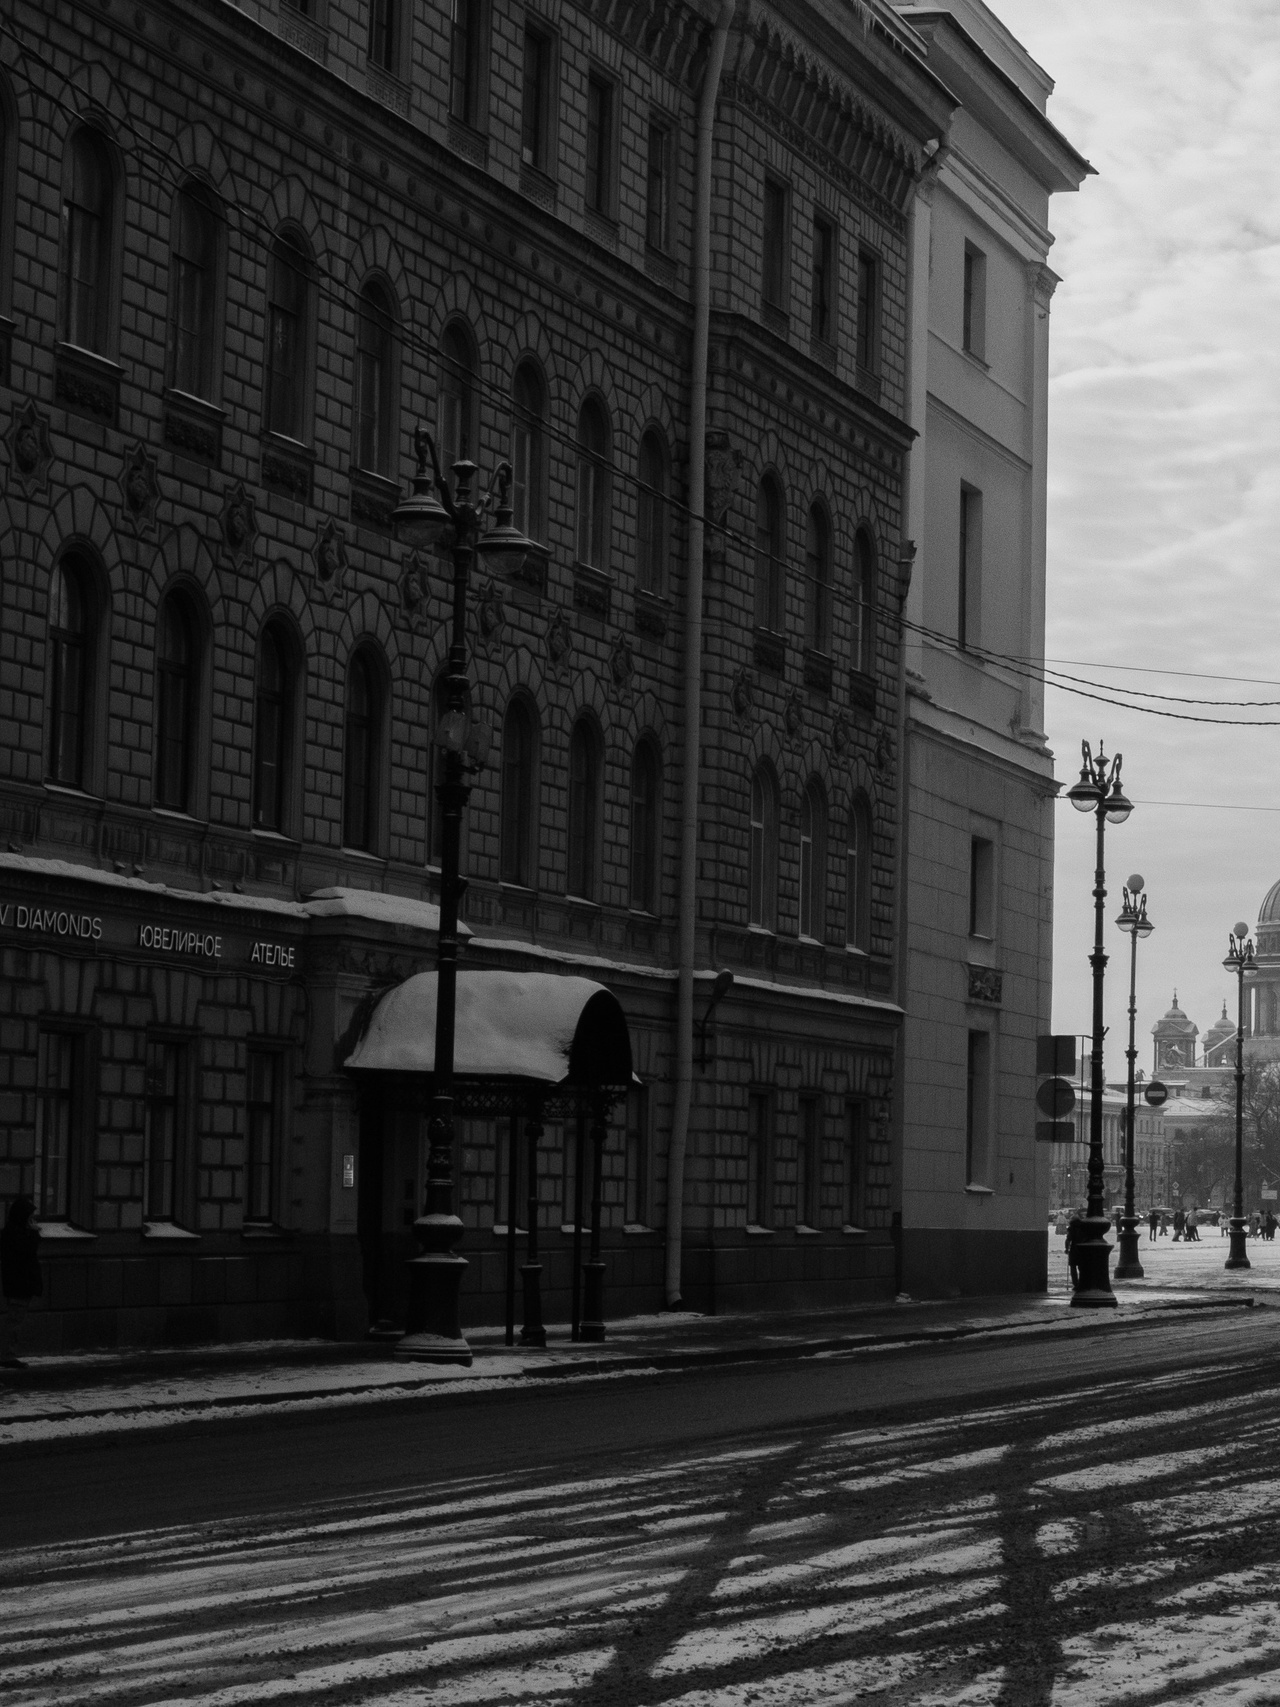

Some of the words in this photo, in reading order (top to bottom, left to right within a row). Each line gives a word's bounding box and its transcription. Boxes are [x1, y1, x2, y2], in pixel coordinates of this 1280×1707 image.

[16, 905, 102, 940] DIAMONDS
[140, 925, 222, 957] ЮВЕЛИРНОЕ
[251, 942, 295, 968] АТЕЛЬЕ
